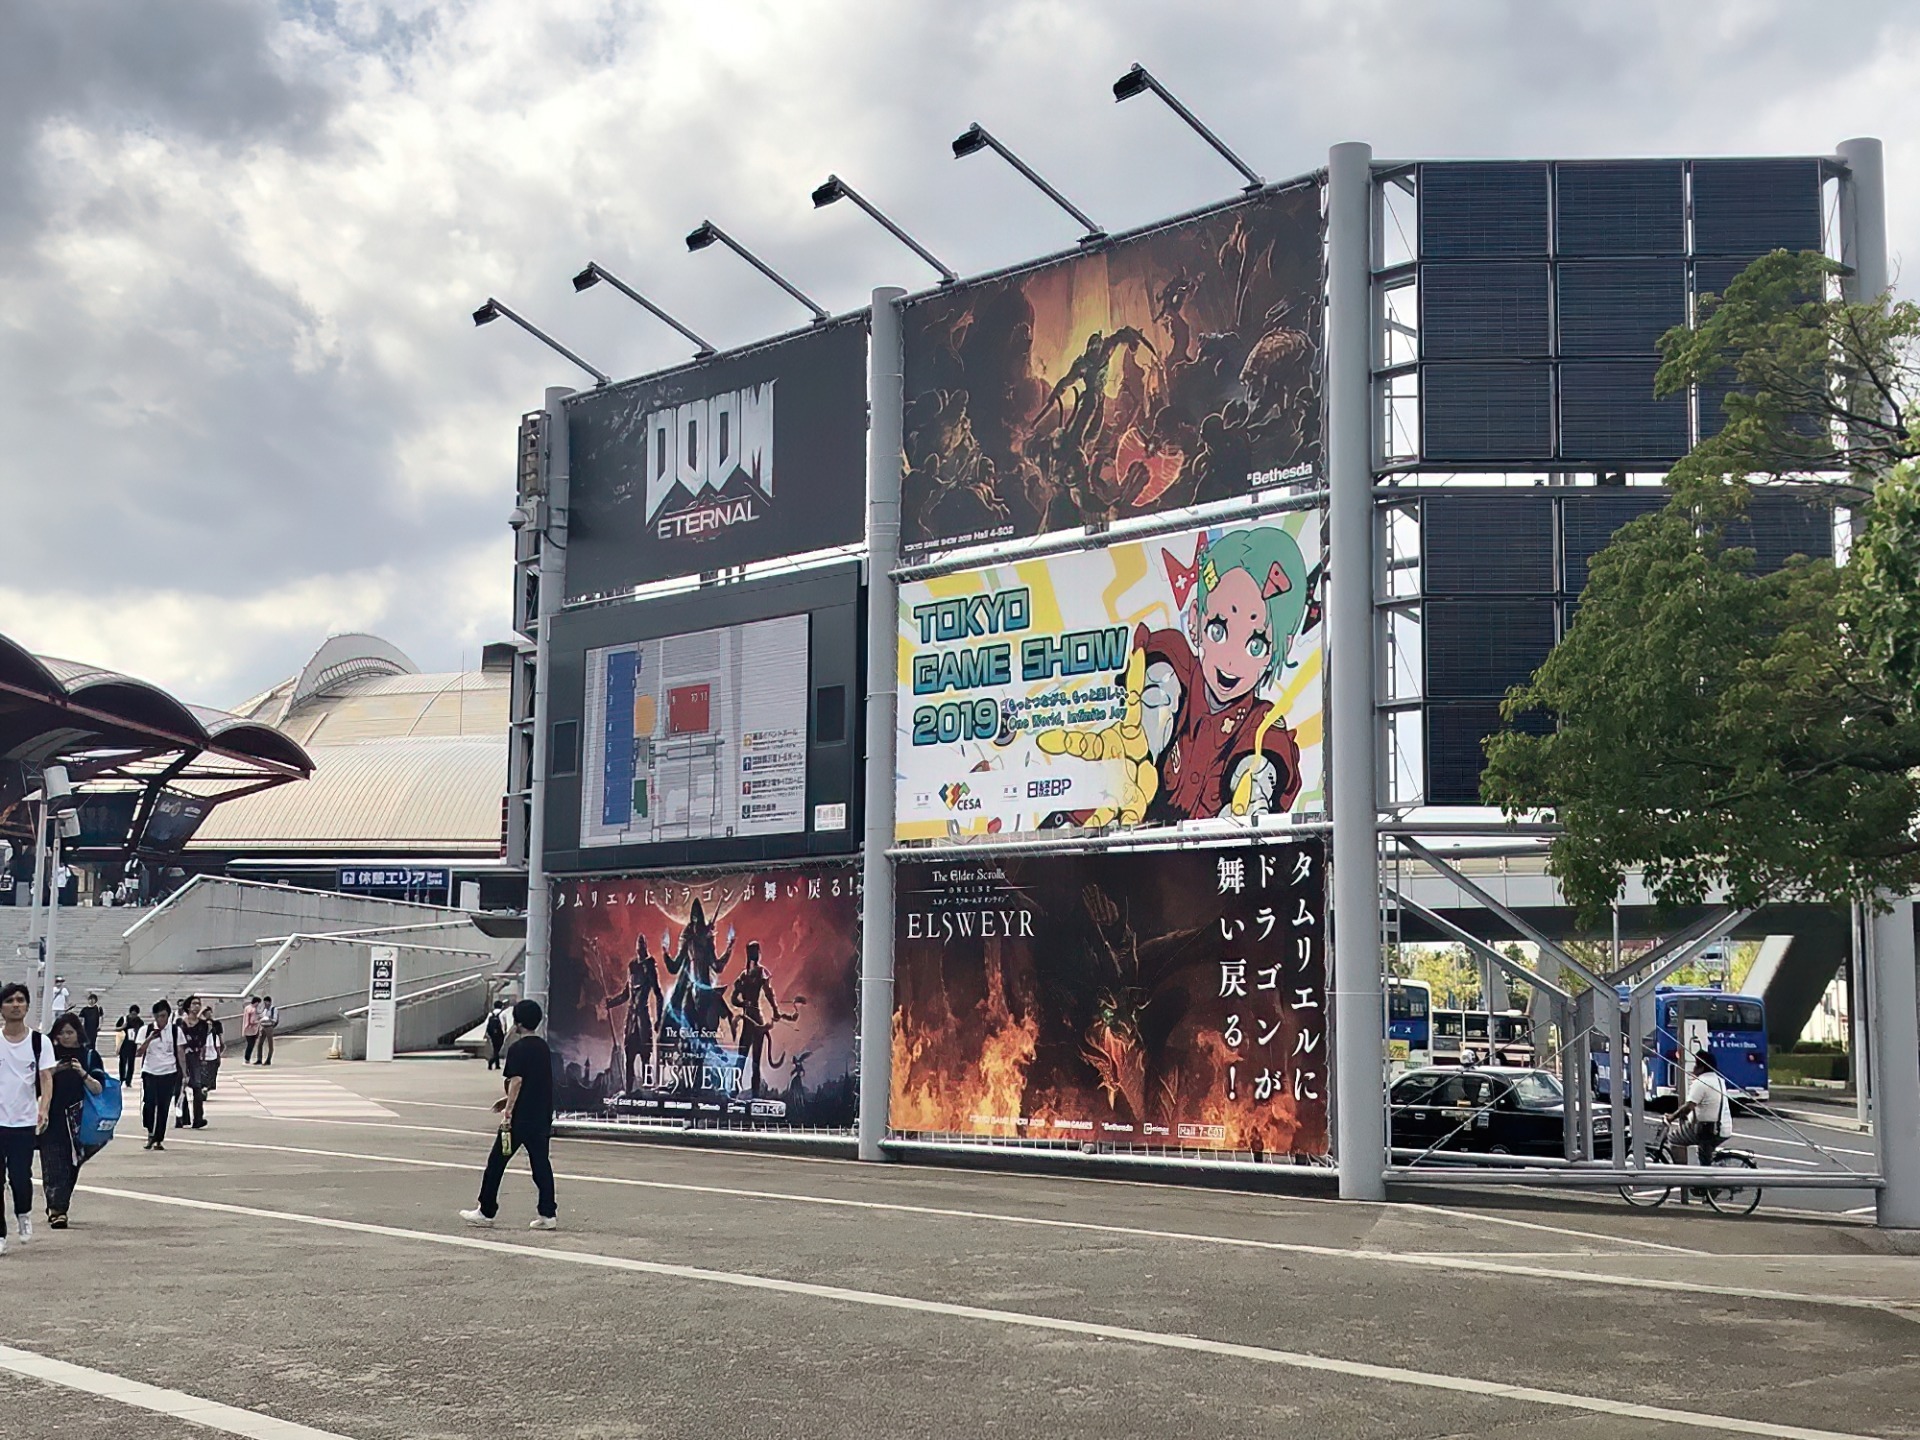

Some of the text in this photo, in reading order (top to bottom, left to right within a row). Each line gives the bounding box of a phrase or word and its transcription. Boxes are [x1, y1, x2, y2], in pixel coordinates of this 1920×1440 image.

[646, 378, 778, 526] DOOM
[1252, 462, 1313, 486] Bethesda
[658, 500, 760, 539] ETERNAL
[914, 587, 1030, 644] TOKYO
[913, 626, 1128, 695] GAME SHOW
[913, 698, 998, 746] 2019
[1008, 714, 1030, 731] One
[956, 798, 982, 811] CESA
[932, 867, 1006, 884] The Elder Scrolls
[949, 885, 991, 894] ONLINE
[907, 910, 1035, 946] ELSWEYR
[1254, 854, 1282, 1100] ドラゴンが
[1290, 851, 1320, 1101] タムリエルに
[642, 1064, 744, 1095] ELSWEYR
